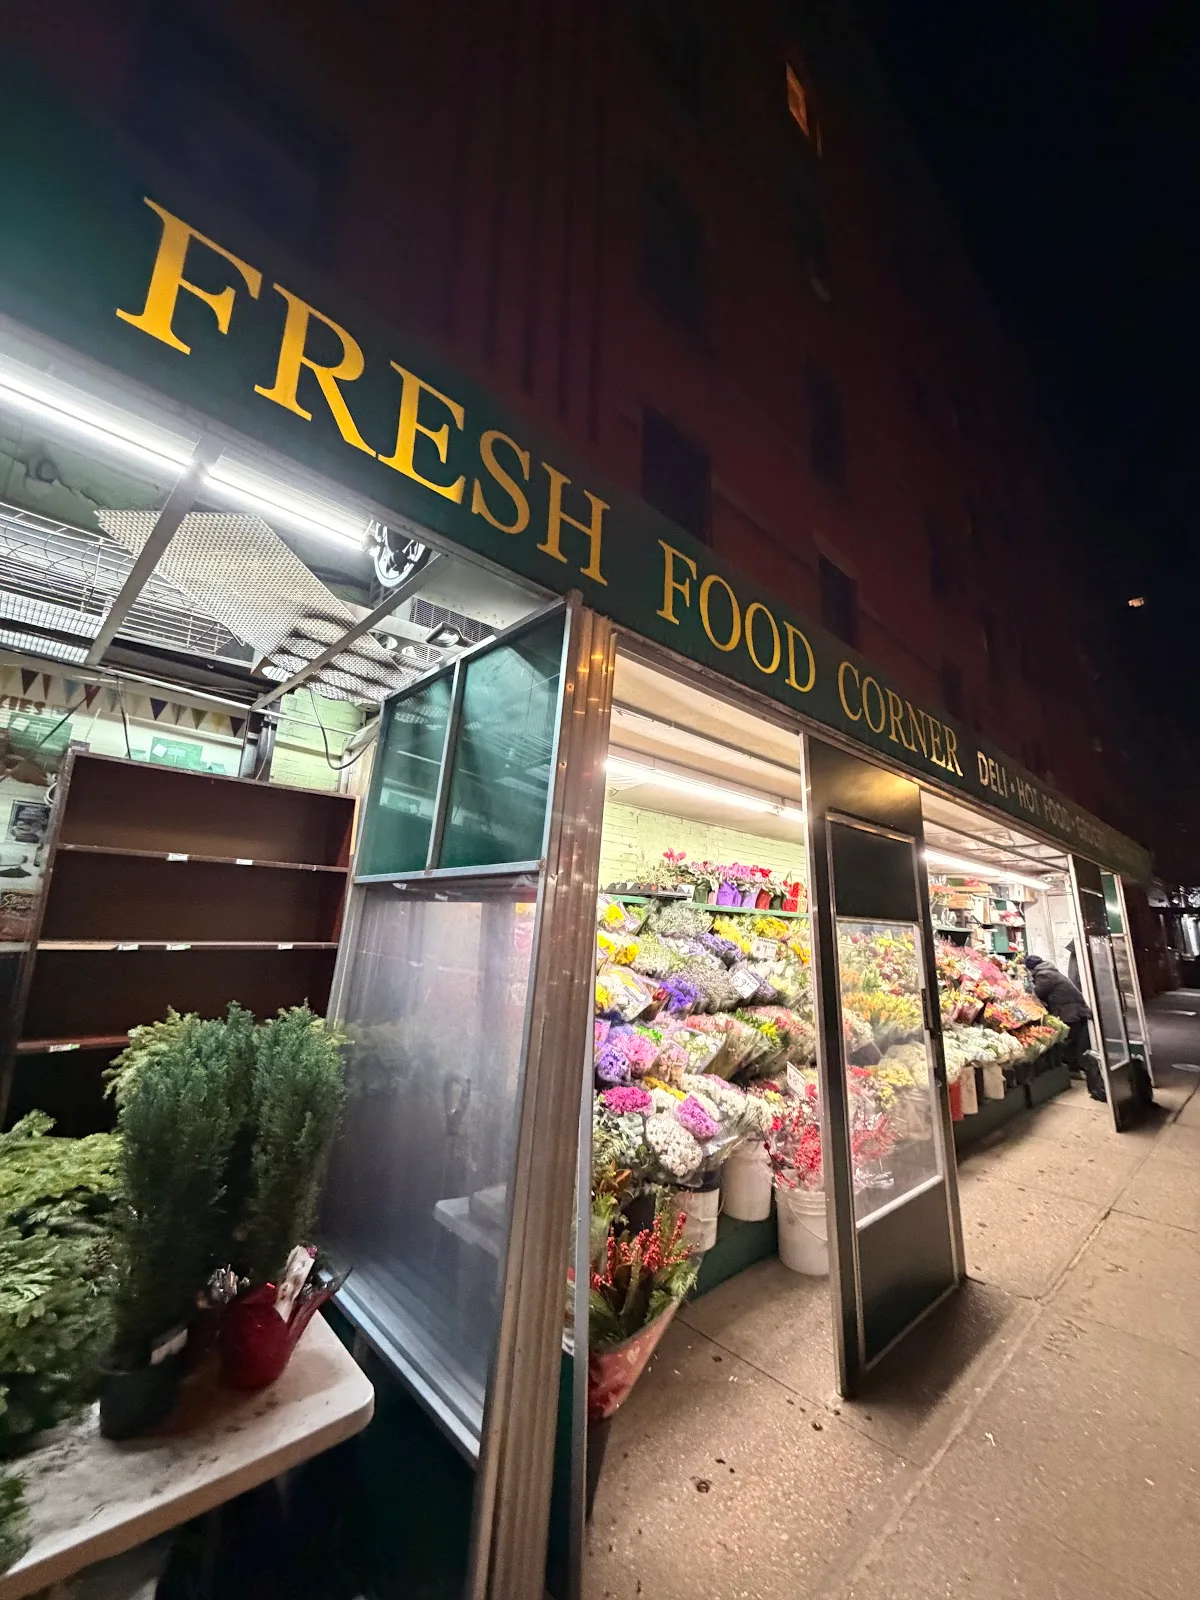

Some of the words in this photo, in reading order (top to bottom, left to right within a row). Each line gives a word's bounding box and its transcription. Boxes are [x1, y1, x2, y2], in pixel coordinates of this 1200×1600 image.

[115, 196, 611, 587] FRESH
[656, 538, 816, 692] FOOD
[838, 661, 964, 777] CORNER
[977, 751, 1008, 798] DELI
[1016, 776, 1040, 816] HOT
